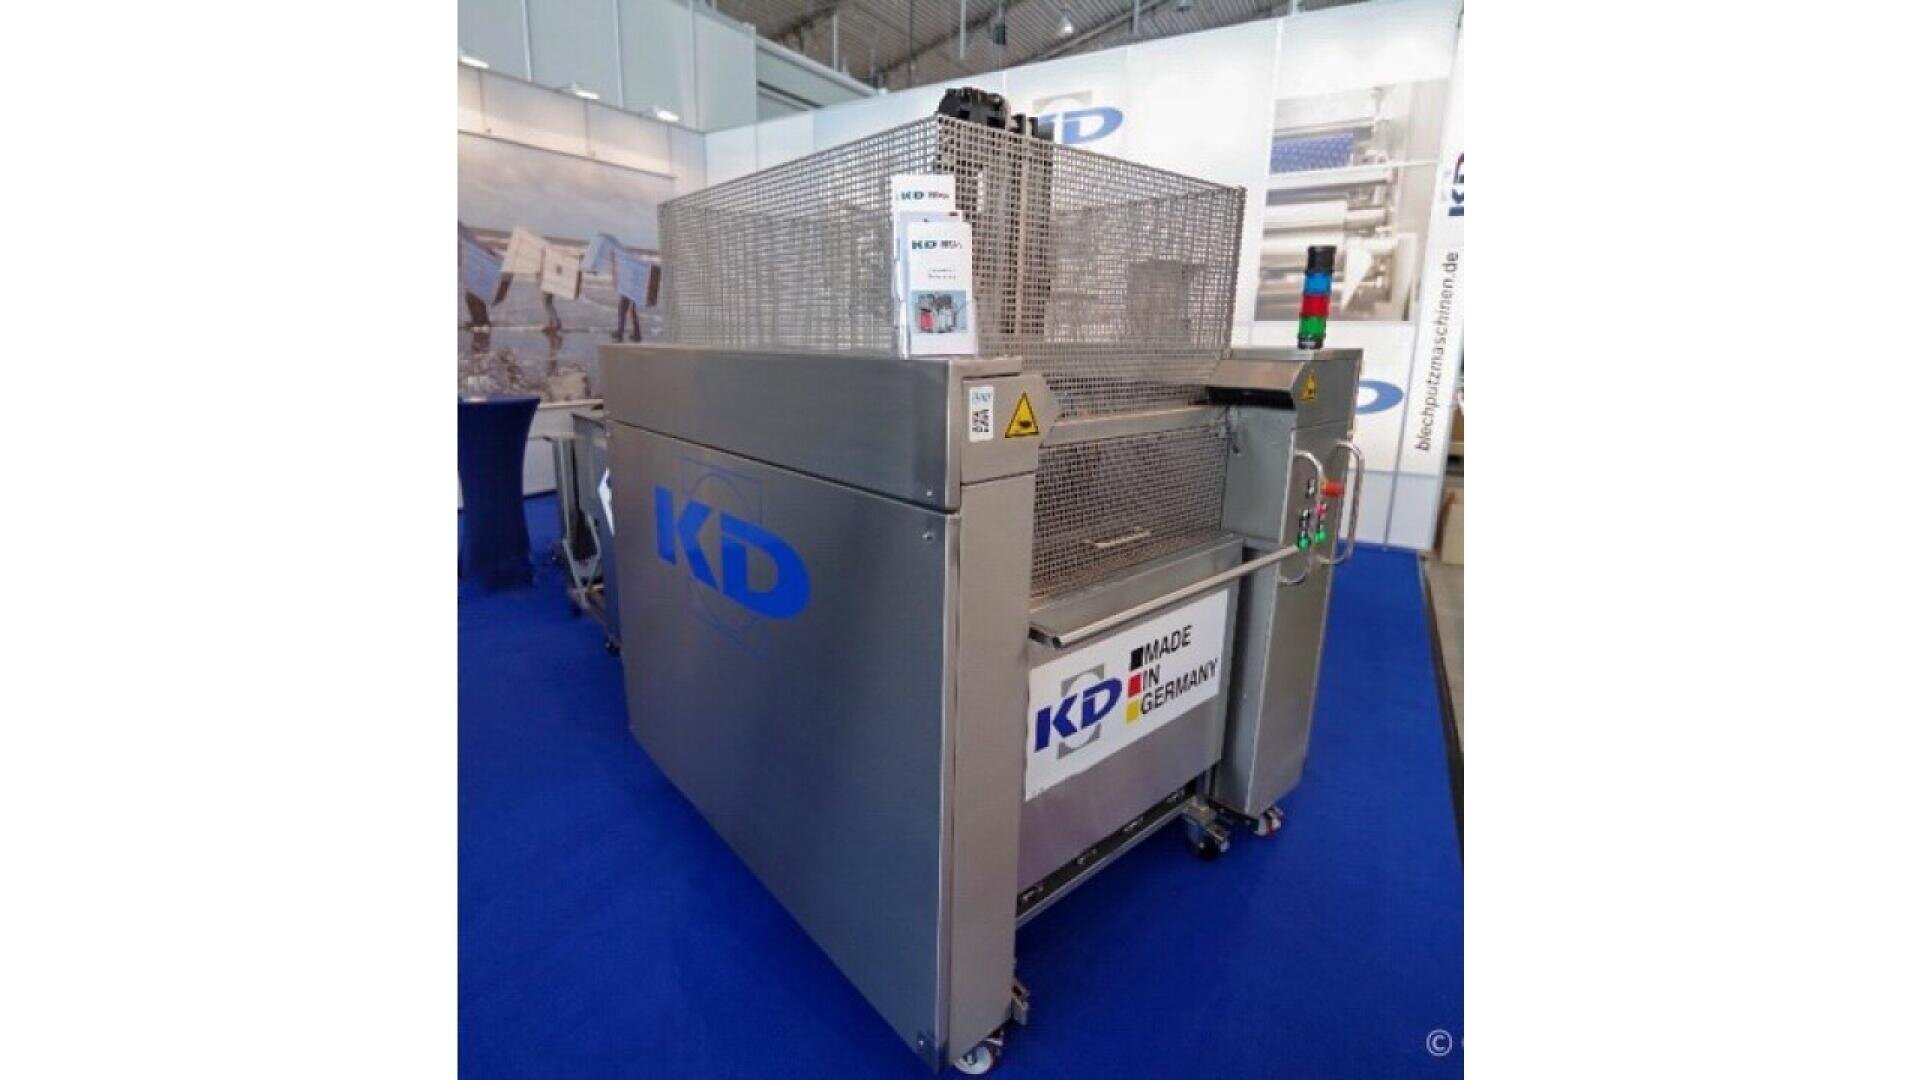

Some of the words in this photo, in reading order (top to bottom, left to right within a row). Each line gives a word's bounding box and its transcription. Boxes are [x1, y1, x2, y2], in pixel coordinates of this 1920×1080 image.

[1416, 252, 1459, 451] blechputzmaschinen.de
[654, 484, 812, 620] KD
[1142, 664, 1160, 691] IN
[1143, 625, 1192, 665] MADE
[1034, 678, 1123, 753] KD
[1140, 658, 1218, 715] GERMANY
